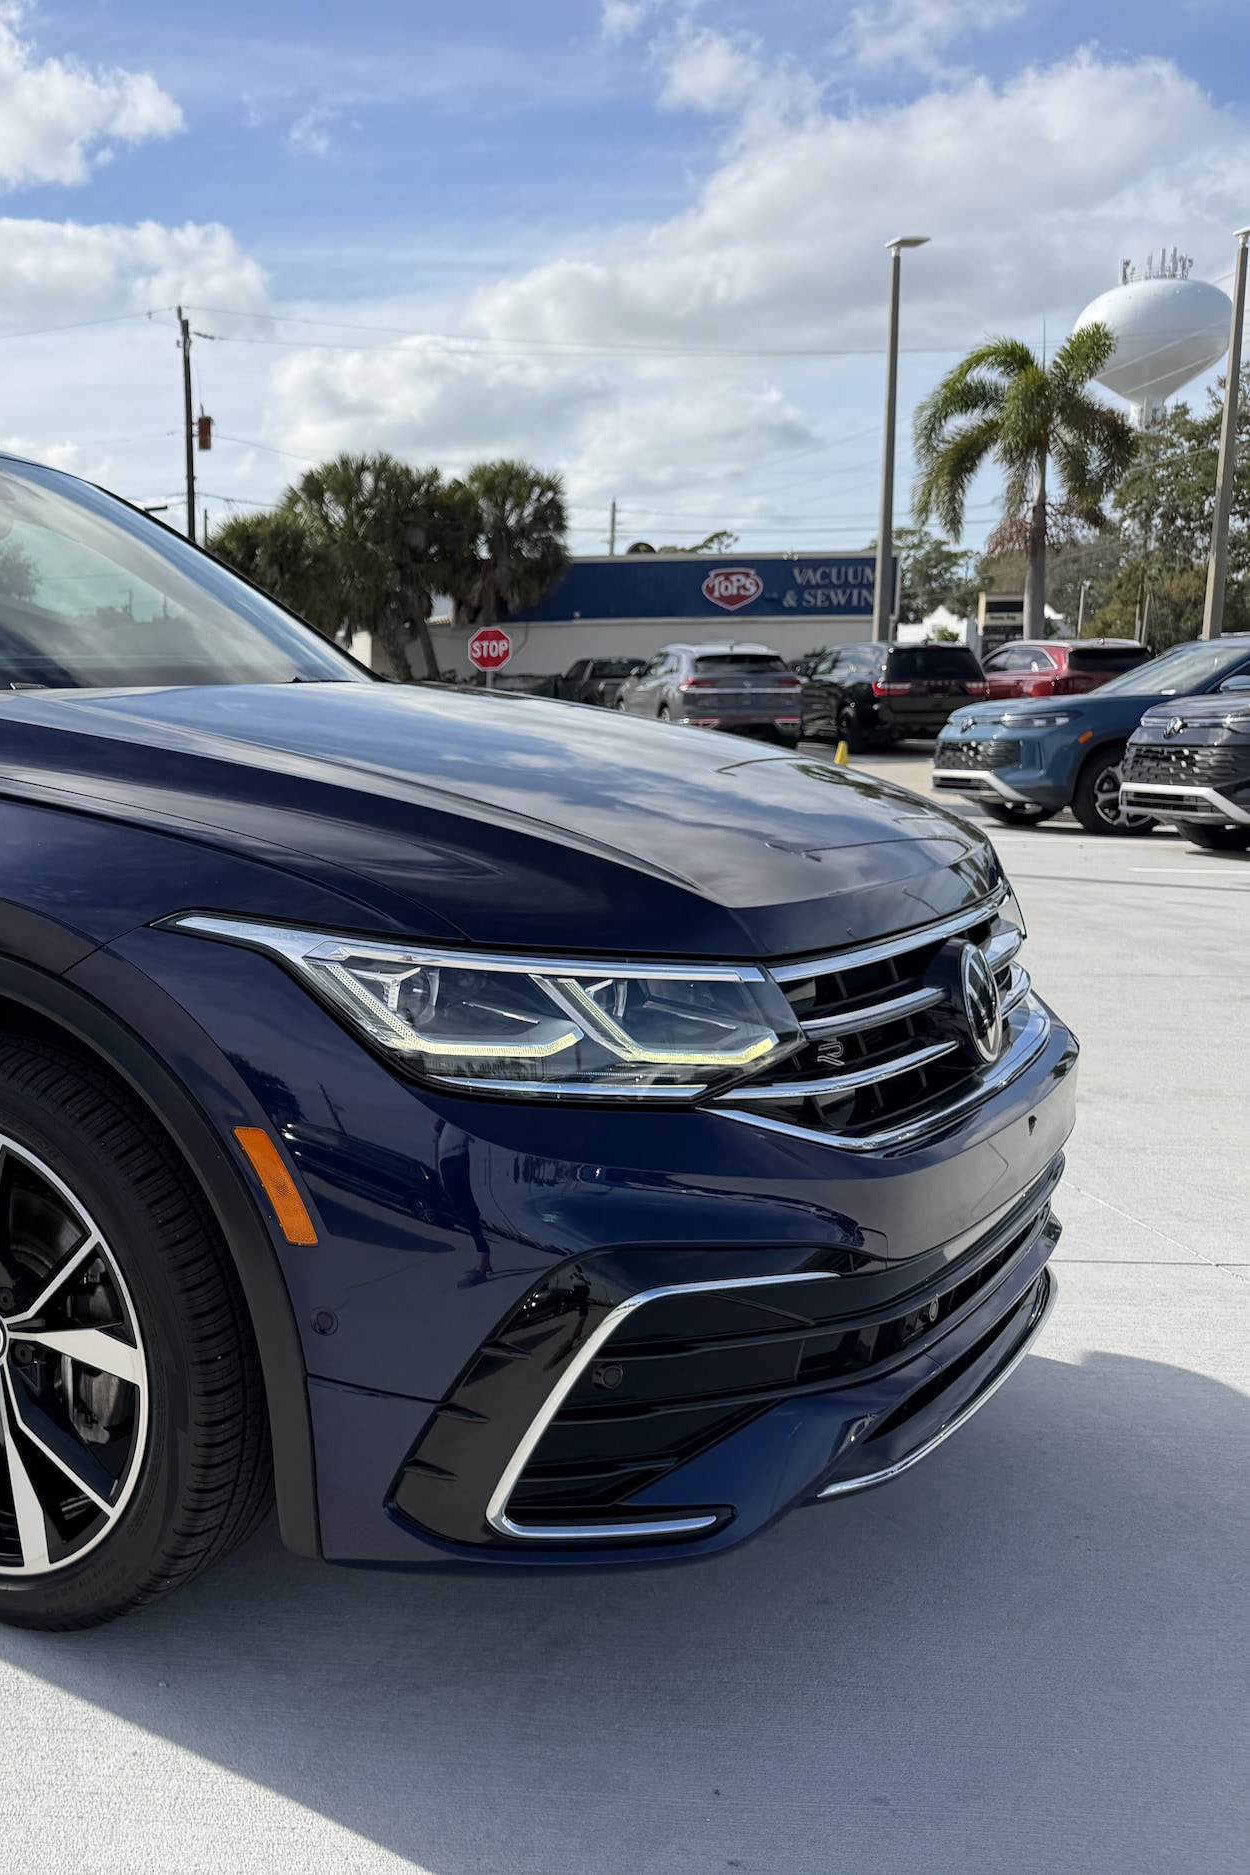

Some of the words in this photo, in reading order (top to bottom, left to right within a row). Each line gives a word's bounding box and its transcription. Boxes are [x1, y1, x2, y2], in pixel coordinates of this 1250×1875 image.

[792, 565, 876, 586] VACUUM
[782, 590, 799, 609] &
[802, 588, 874, 609] SEWIN
[471, 640, 509, 658] STOP
